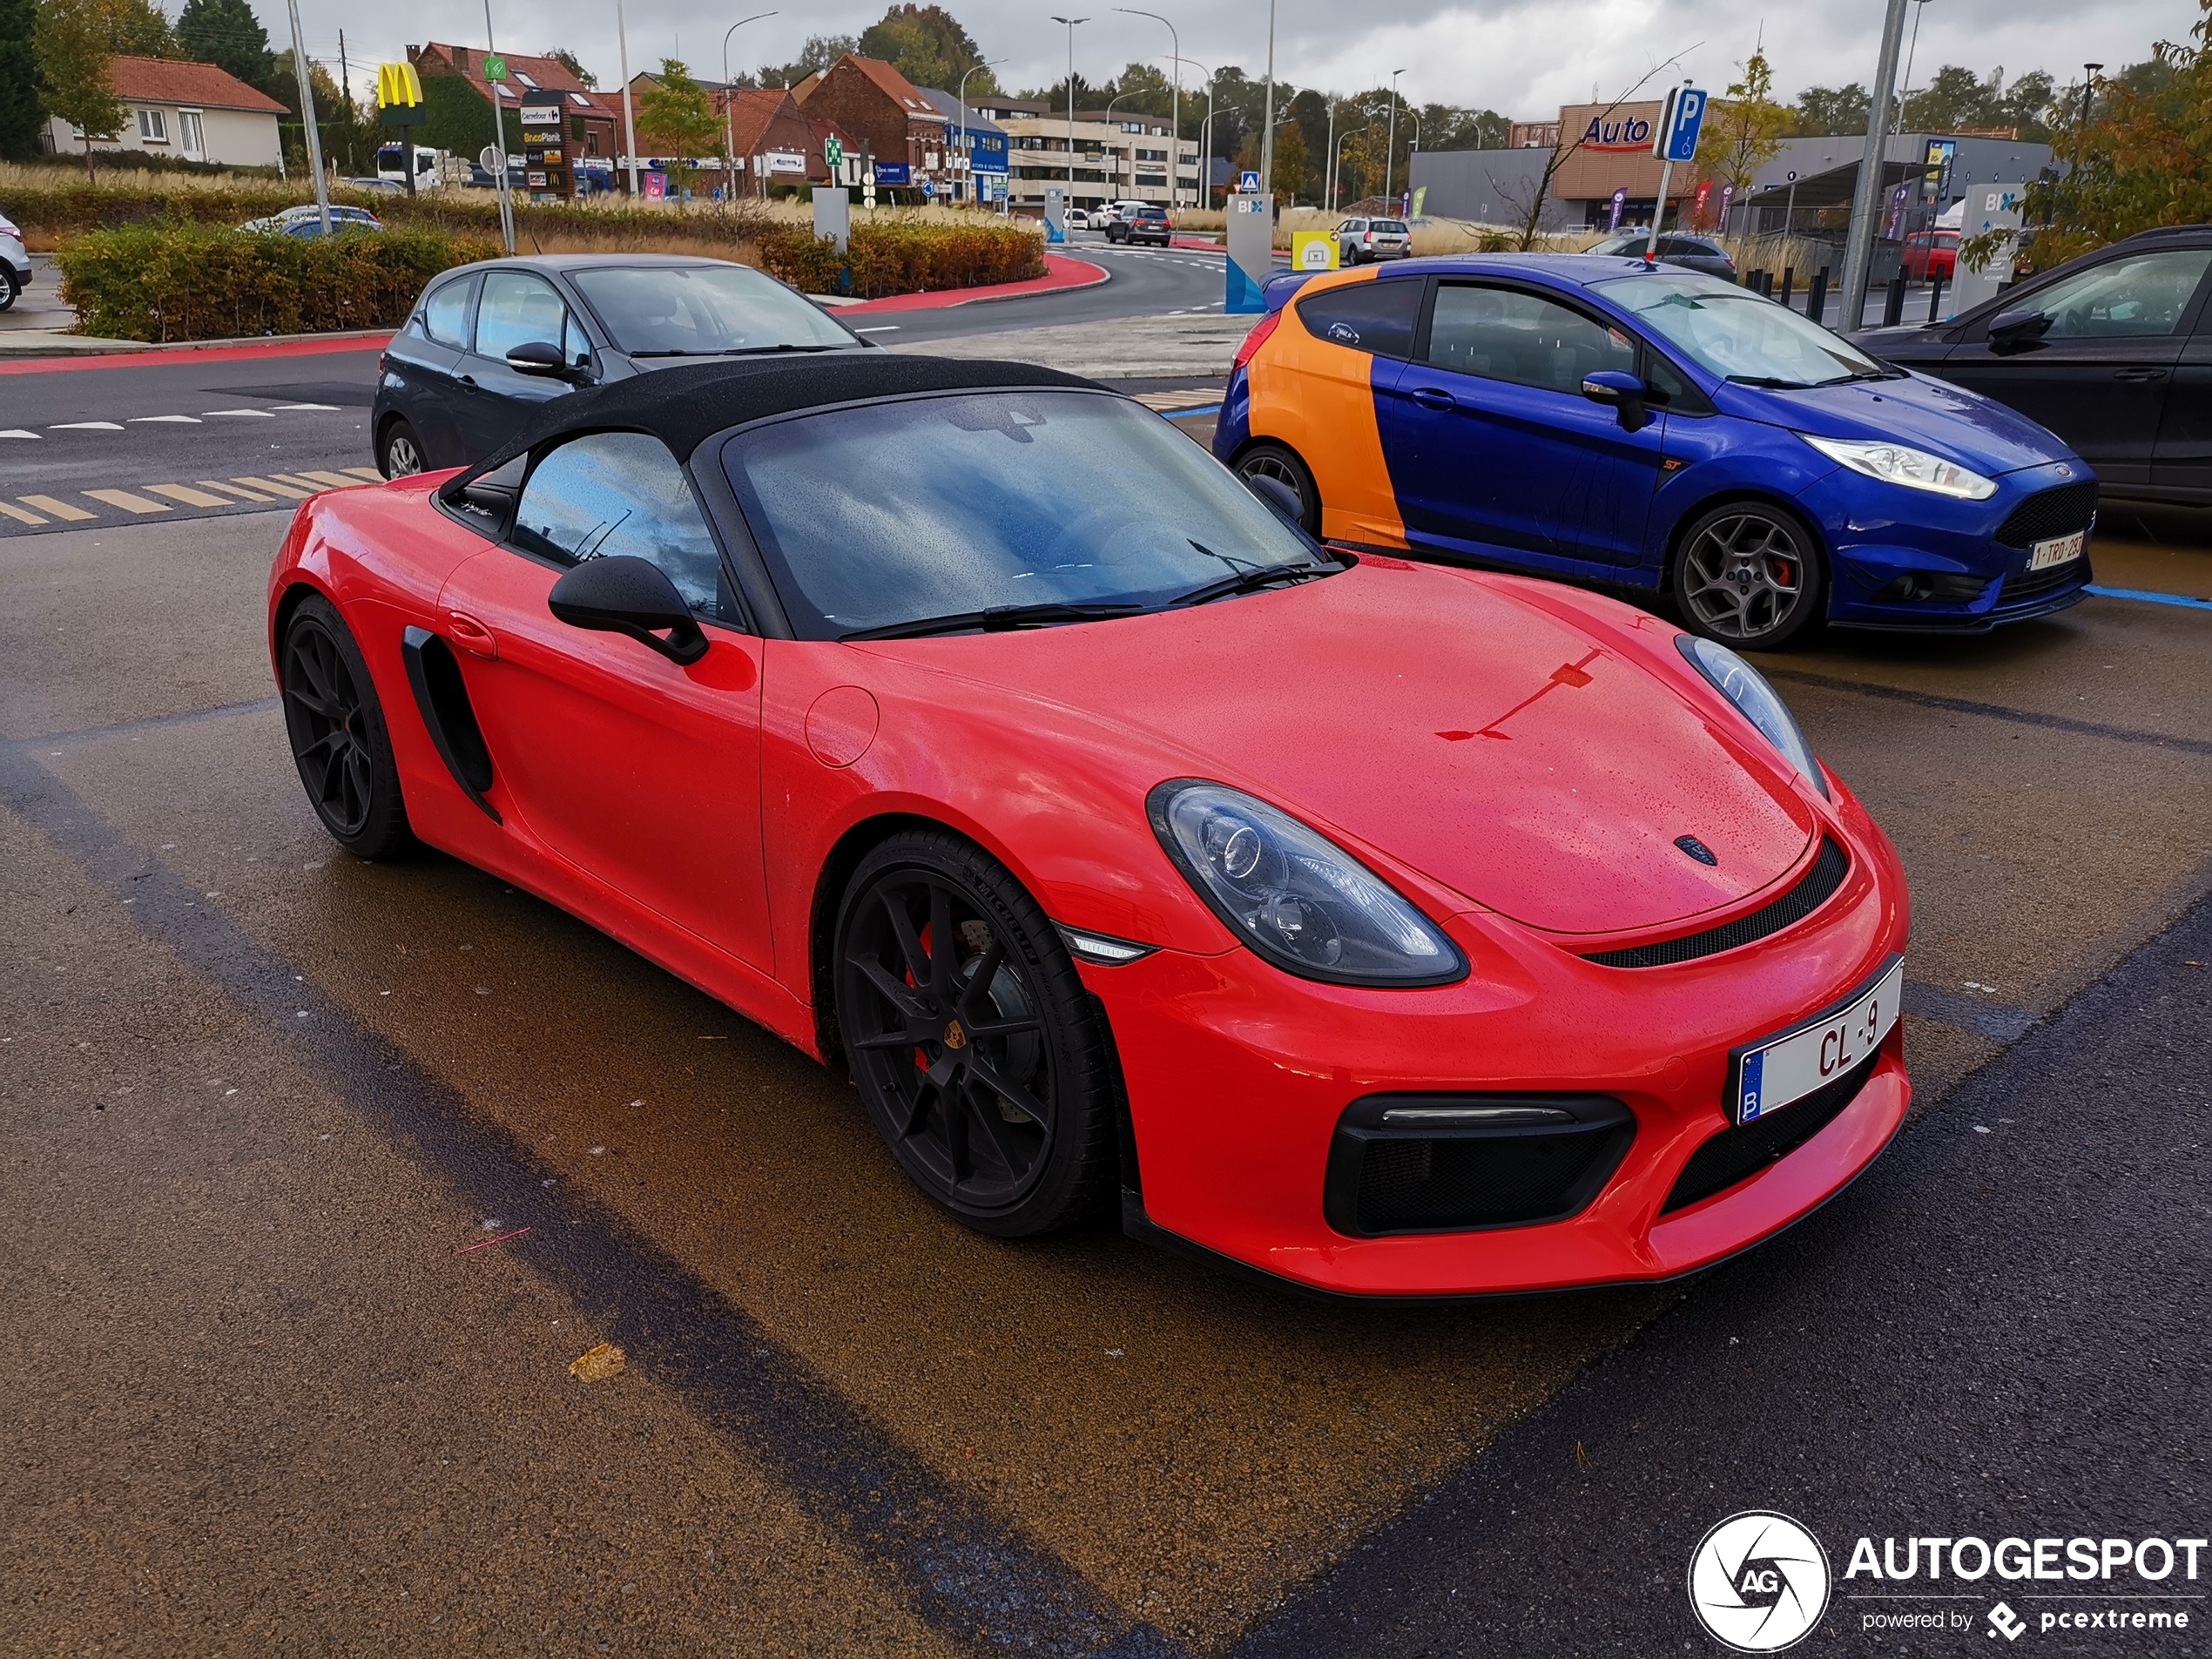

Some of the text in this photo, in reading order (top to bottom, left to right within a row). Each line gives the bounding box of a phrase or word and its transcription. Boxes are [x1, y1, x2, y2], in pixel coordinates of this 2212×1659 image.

[1679, 93, 1700, 132] P
[524, 132, 562, 143] BricoPlanit
[1581, 116, 1651, 144] Auto
[1238, 200, 1263, 213] BIX
[1663, 459, 1681, 470] ST
[977, 883, 1038, 964] MICHELIN
[1744, 1091, 1757, 1115] B
